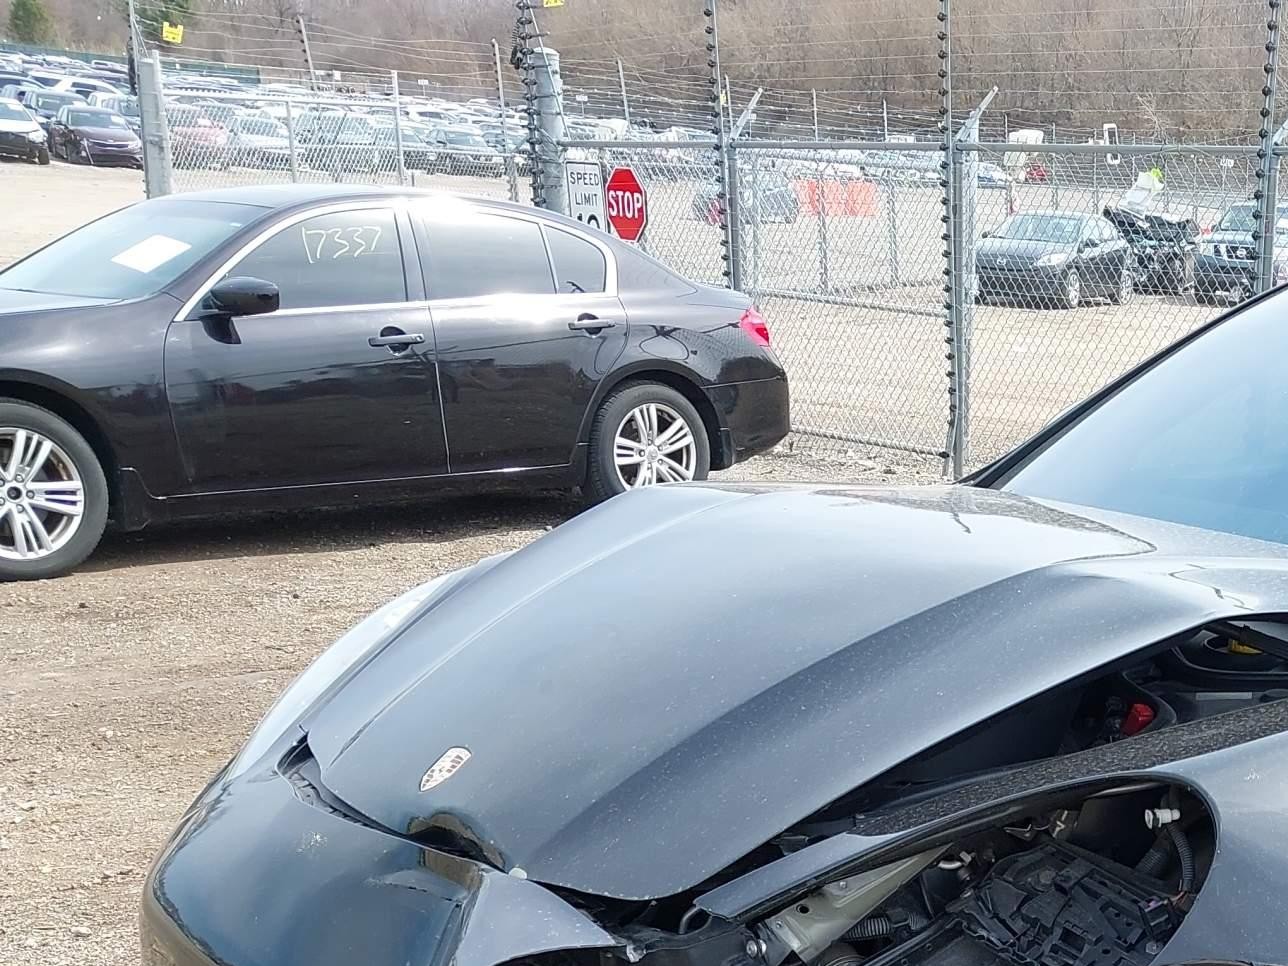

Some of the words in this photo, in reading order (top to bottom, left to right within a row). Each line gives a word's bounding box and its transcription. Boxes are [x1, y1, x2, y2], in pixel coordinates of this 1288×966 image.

[569, 171, 600, 187] SPEED
[574, 192, 598, 207] LIMIT
[608, 190, 642, 219] STOP
